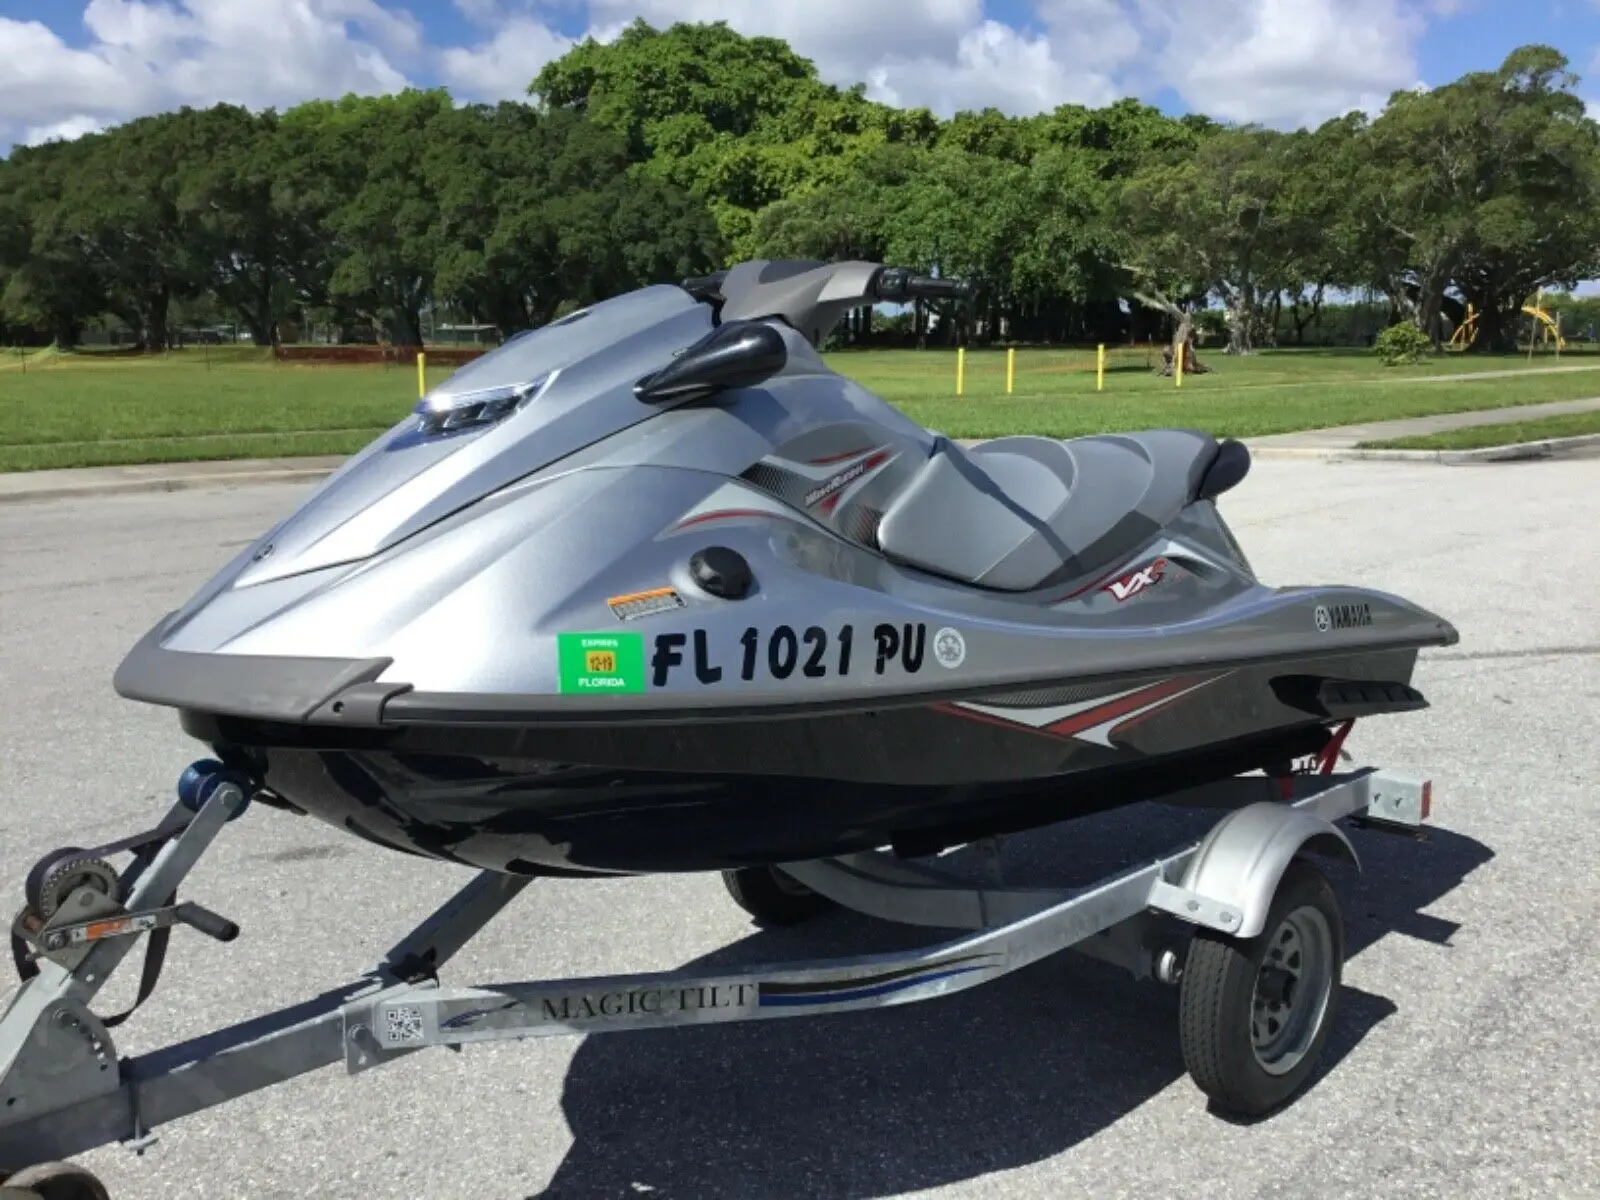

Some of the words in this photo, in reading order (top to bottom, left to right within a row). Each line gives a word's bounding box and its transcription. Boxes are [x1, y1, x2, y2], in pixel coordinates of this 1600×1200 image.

[652, 629, 722, 687] FL
[740, 624, 853, 681] 1021
[874, 622, 927, 675] PU
[578, 677, 626, 688] FLORIDA
[543, 989, 664, 1020] MAGIC
[670, 983, 754, 1010] TILT
